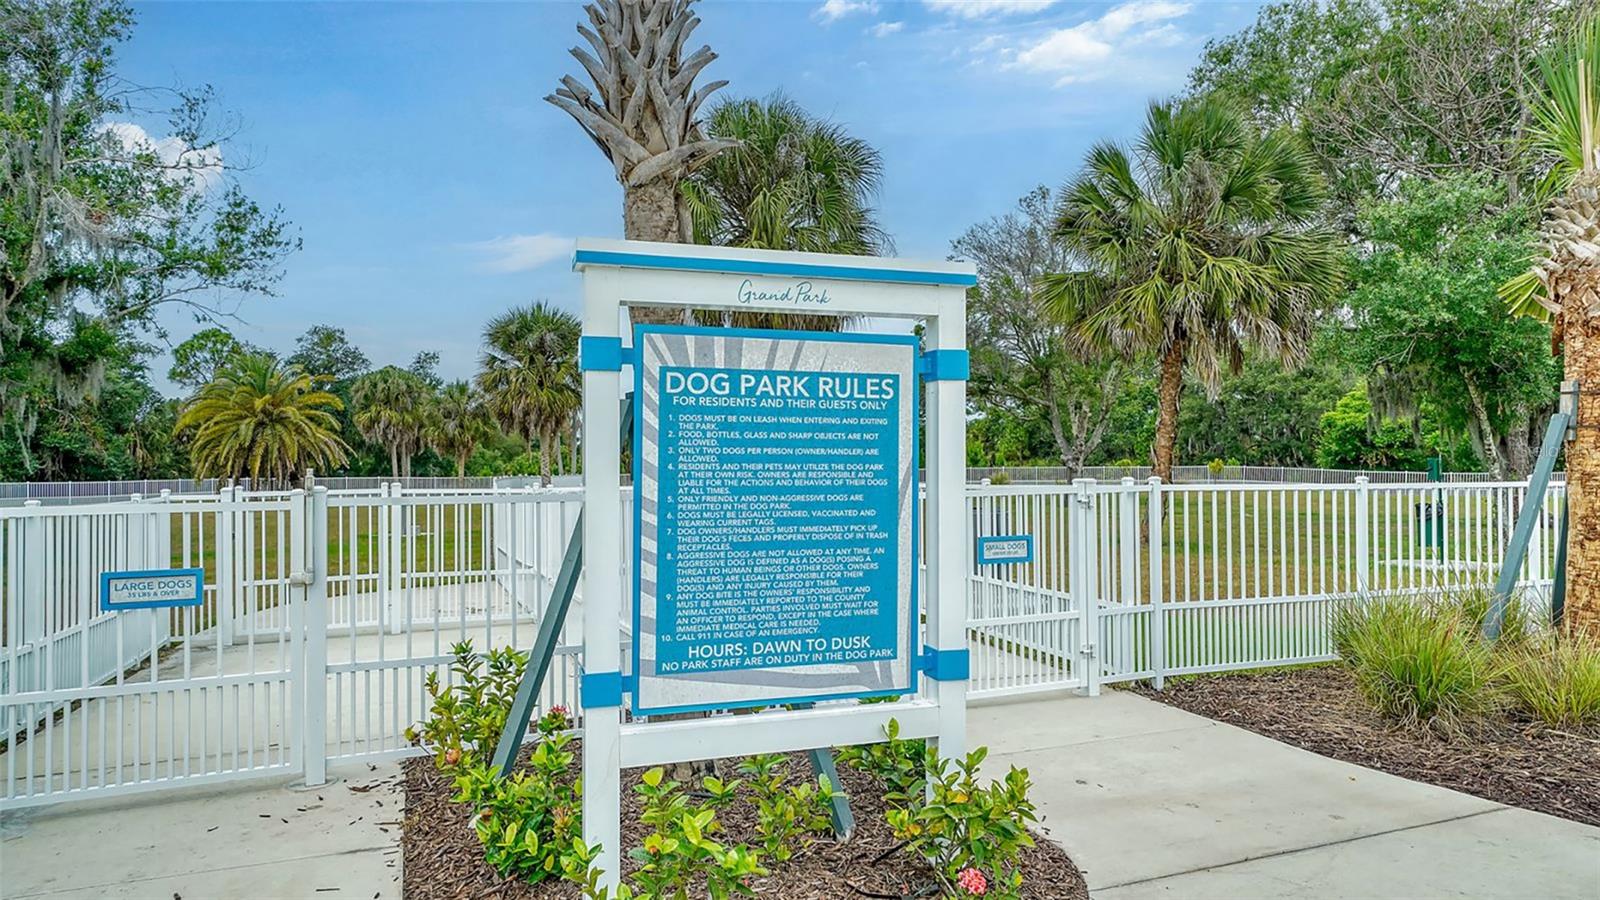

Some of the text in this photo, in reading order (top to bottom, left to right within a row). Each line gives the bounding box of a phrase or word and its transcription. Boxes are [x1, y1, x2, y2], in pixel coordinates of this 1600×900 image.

[738, 279, 831, 304] Grand Park
[666, 372, 894, 399] DOG PARK RULES
[673, 396, 887, 410] FOR RESIDENTS AND THEIR GUESTS ONLY
[679, 414, 702, 422] DOGS
[679, 422, 695, 430] THE
[814, 432, 846, 440] OBJECTS
[678, 479, 705, 487] LIABLE
[833, 478, 845, 486] OF
[678, 487, 689, 495] AT
[690, 487, 705, 495] ALL
[677, 503, 722, 511] PERMITTED
[749, 502, 769, 510] DOG
[677, 511, 702, 519] DOGS
[702, 511, 725, 519] MUST
[726, 511, 737, 519] BE
[811, 509, 859, 517] VACCINATED
[677, 519, 716, 527] WEARING
[716, 519, 753, 527] CURRENT
[1007, 542, 1026, 550] DOGS
[114, 579, 192, 592] LARGE DOGS
[677, 584, 705, 593] DOG(S)
[706, 583, 725, 591] AND
[744, 581, 772, 590] INJURY
[773, 580, 804, 589] CAUSED
[804, 580, 815, 588] BY
[677, 593, 694, 601] ANY
[695, 591, 715, 600] DOG
[715, 591, 734, 599] BITE
[734, 590, 742, 598] IS
[743, 590, 759, 598] THE
[796, 586, 853, 596] RESPONSIBILITY
[676, 593, 865, 609] MUST BE IMMEDIATELY REPORTED TO THE COUNTY
[676, 608, 708, 617] ANIMAL
[751, 605, 781, 613] PARTIES
[782, 603, 821, 612] INVOLVED
[821, 602, 842, 610] MUST
[843, 601, 863, 609] WAIT
[863, 600, 879, 609] FOR
[676, 617, 689, 625] AN
[690, 615, 724, 625] OFFICER
[725, 614, 736, 623] TO
[778, 611, 806, 620] EXCEPT
[817, 610, 832, 618] THE
[833, 609, 852, 617] CASE
[853, 608, 879, 616] WHERE
[676, 624, 721, 633] IMMEDIATE
[722, 622, 757, 631] MEDICAL
[758, 620, 780, 629] CARE
[779, 620, 788, 628] IS
[662, 634, 673, 642] 10.
[676, 633, 697, 641] CALL
[696, 632, 711, 640] 911
[723, 630, 745, 639] CASE
[745, 629, 757, 638] OF
[758, 629, 771, 637] AN
[688, 636, 871, 659] HOURS: DAWN TO DUSK
[662, 649, 893, 671] NO PARK STAFF ARE ON DUTY IN THE DOG PARK
